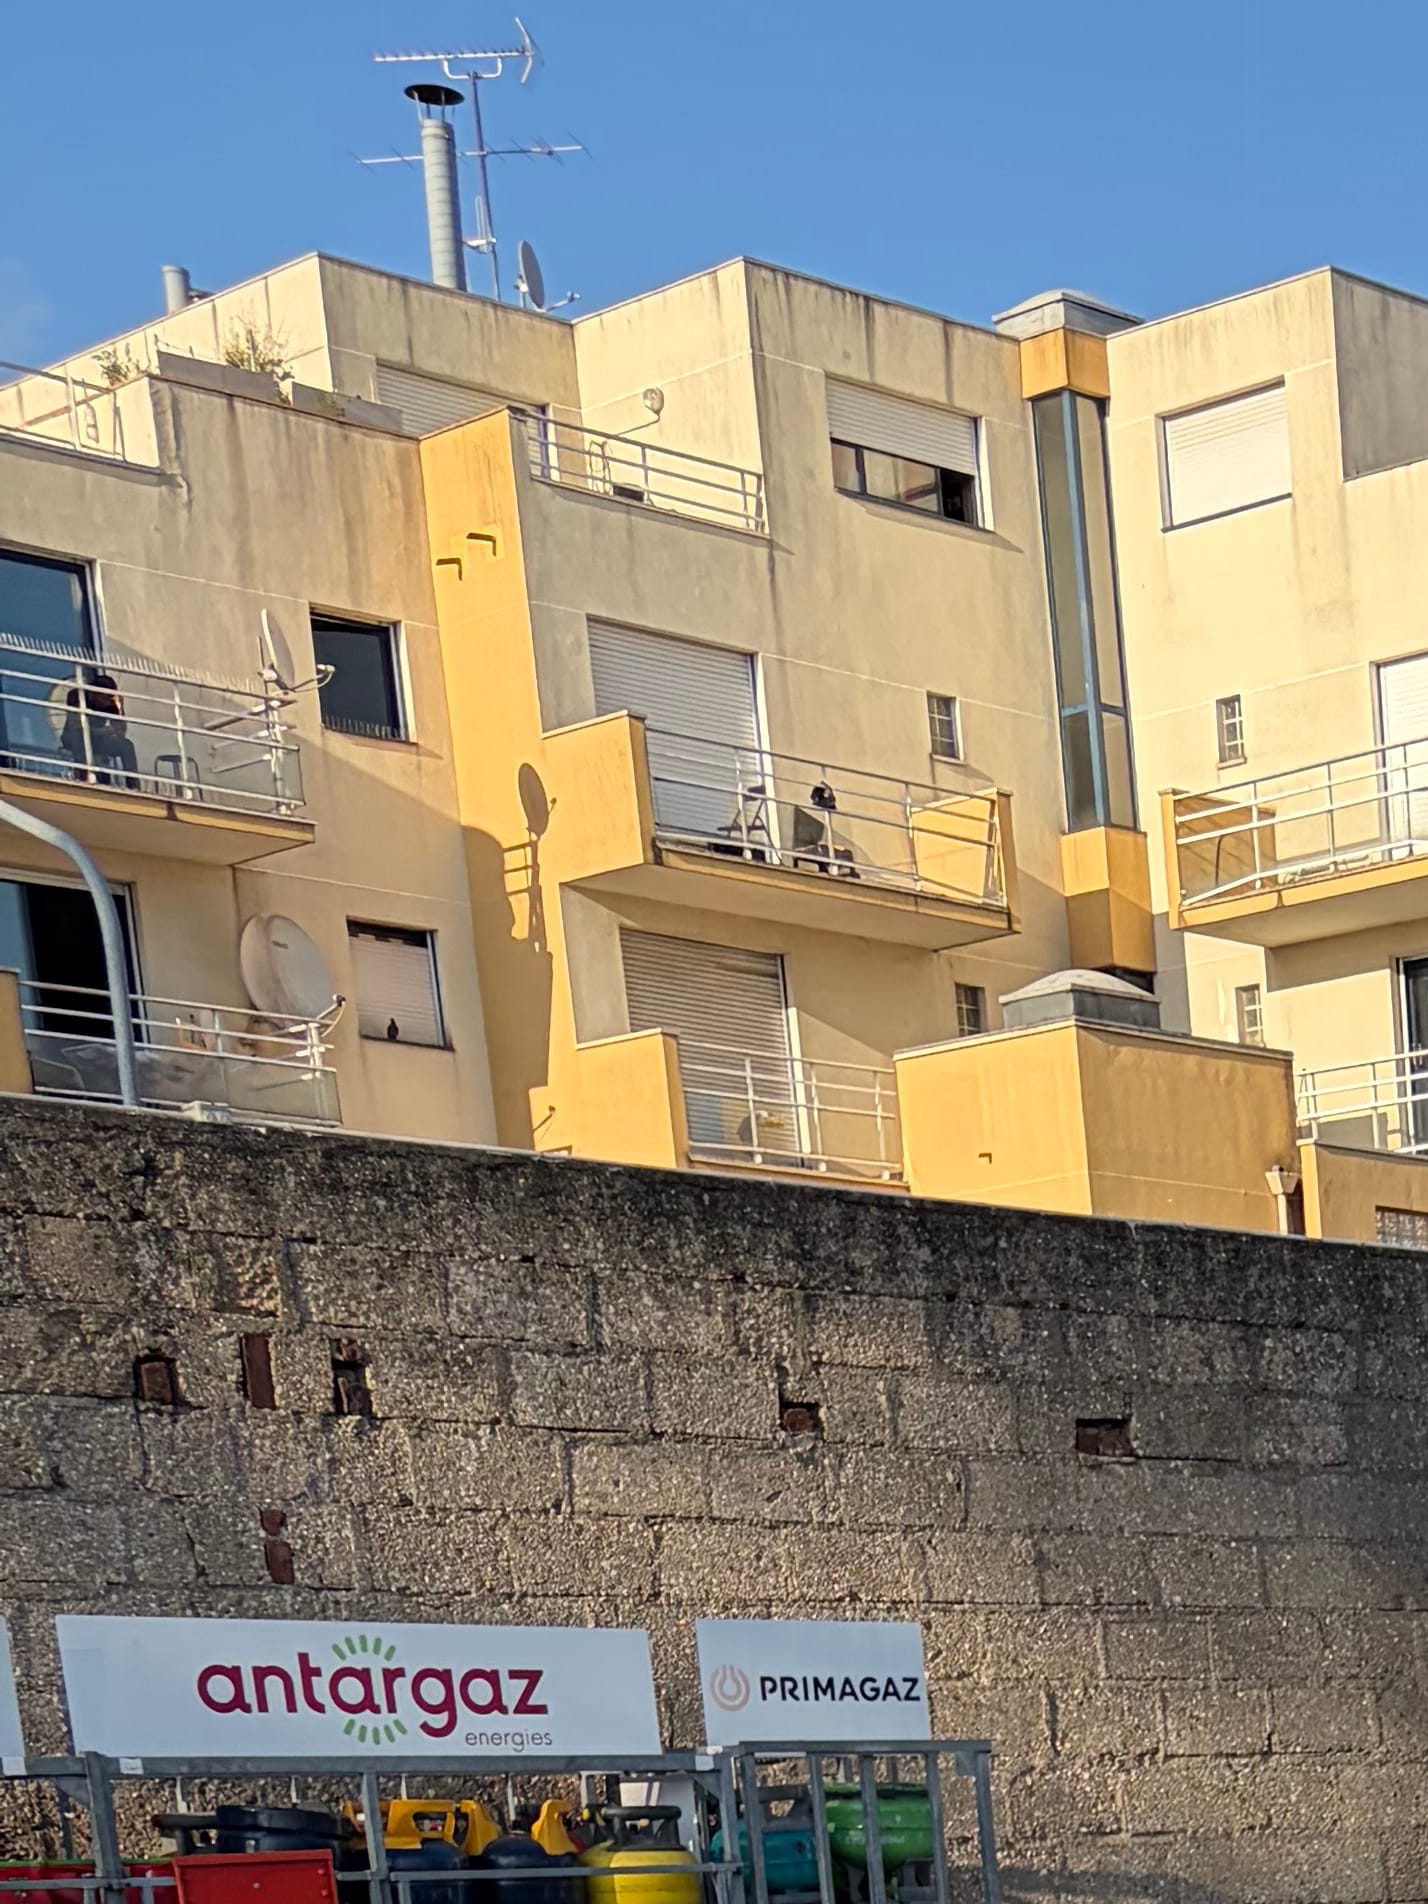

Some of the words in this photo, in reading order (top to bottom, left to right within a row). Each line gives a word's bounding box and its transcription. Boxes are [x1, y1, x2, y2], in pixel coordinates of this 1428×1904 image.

[197, 1652, 548, 1738] antargaz
[760, 1675, 921, 1702] PRIMAGAZ
[465, 1729, 553, 1752] energies
